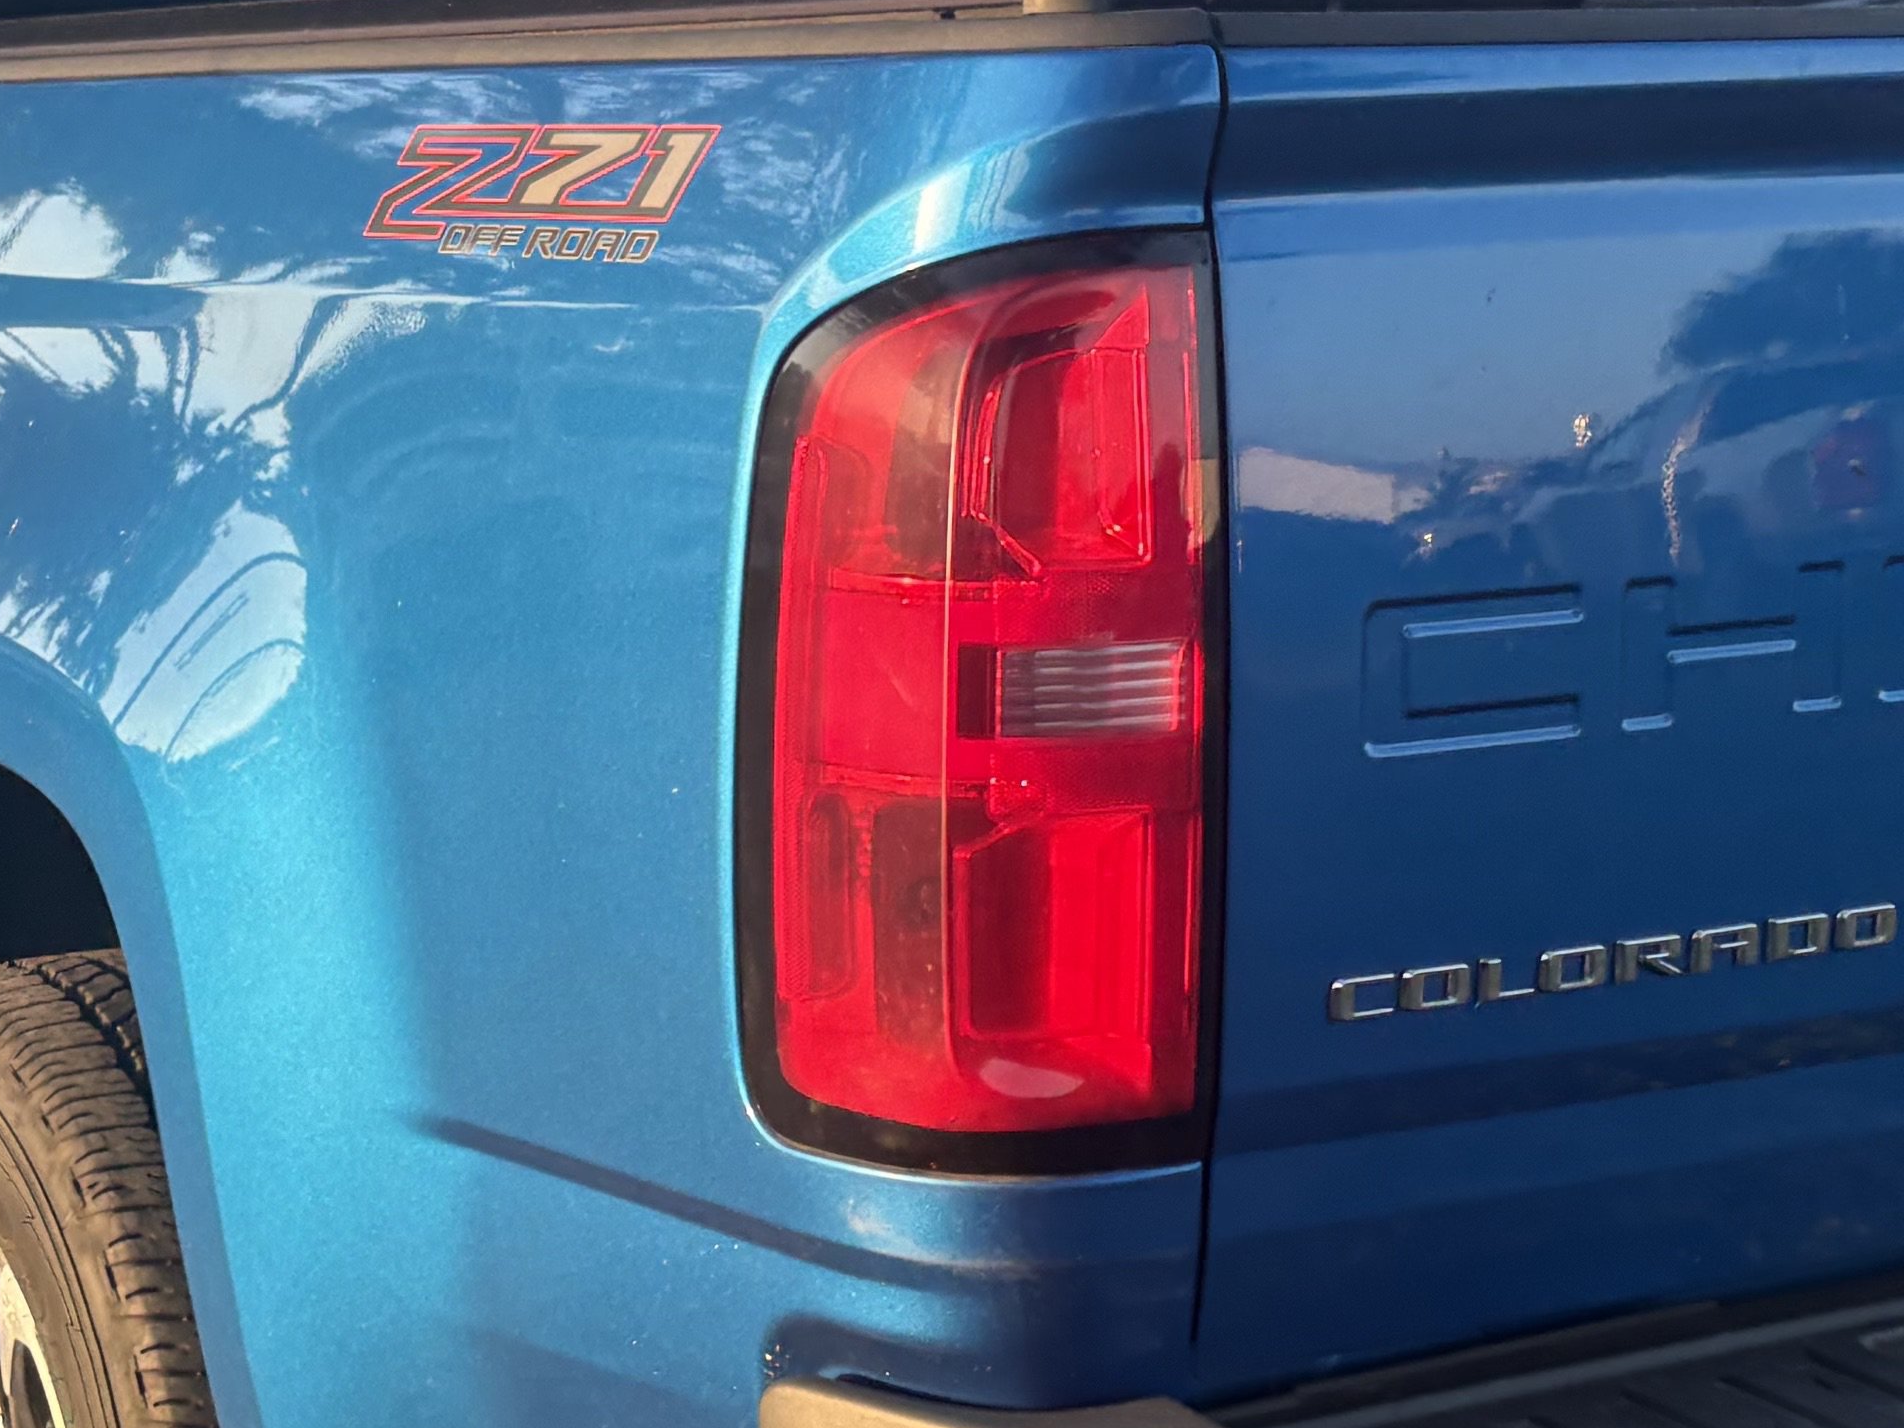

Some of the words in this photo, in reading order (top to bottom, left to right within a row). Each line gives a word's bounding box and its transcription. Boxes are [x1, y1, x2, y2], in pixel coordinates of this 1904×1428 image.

[362, 124, 722, 240] Z71
[438, 222, 526, 256] OFF
[522, 227, 660, 264] ROAD
[1327, 901, 1898, 1022] COLORADO
